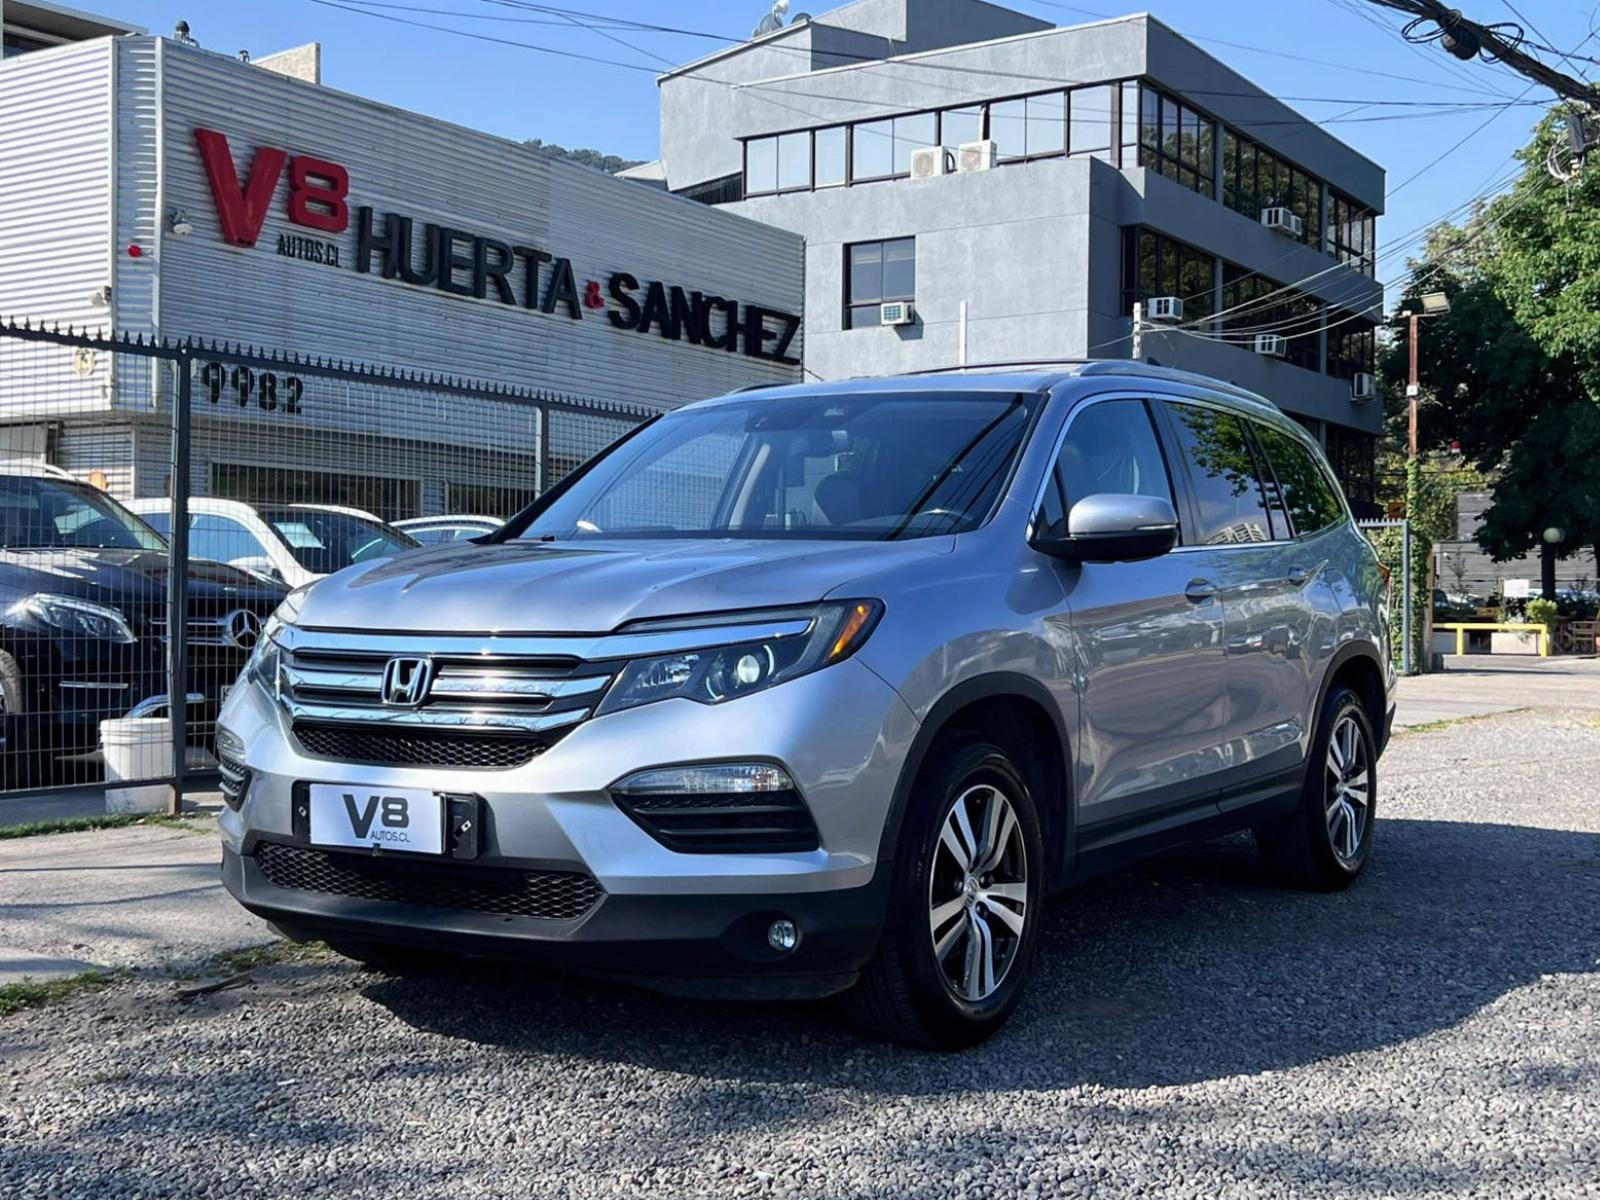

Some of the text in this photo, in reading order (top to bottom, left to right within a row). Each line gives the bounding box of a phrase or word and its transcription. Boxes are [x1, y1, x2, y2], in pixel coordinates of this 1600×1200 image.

[194, 127, 349, 248] V8
[277, 234, 341, 268] AUTOS.CL
[355, 206, 801, 365] HUERTA & SANCHEZ
[202, 362, 303, 414] 9982
[342, 794, 409, 839] V8
[370, 831, 410, 842] AUTOS.CL
